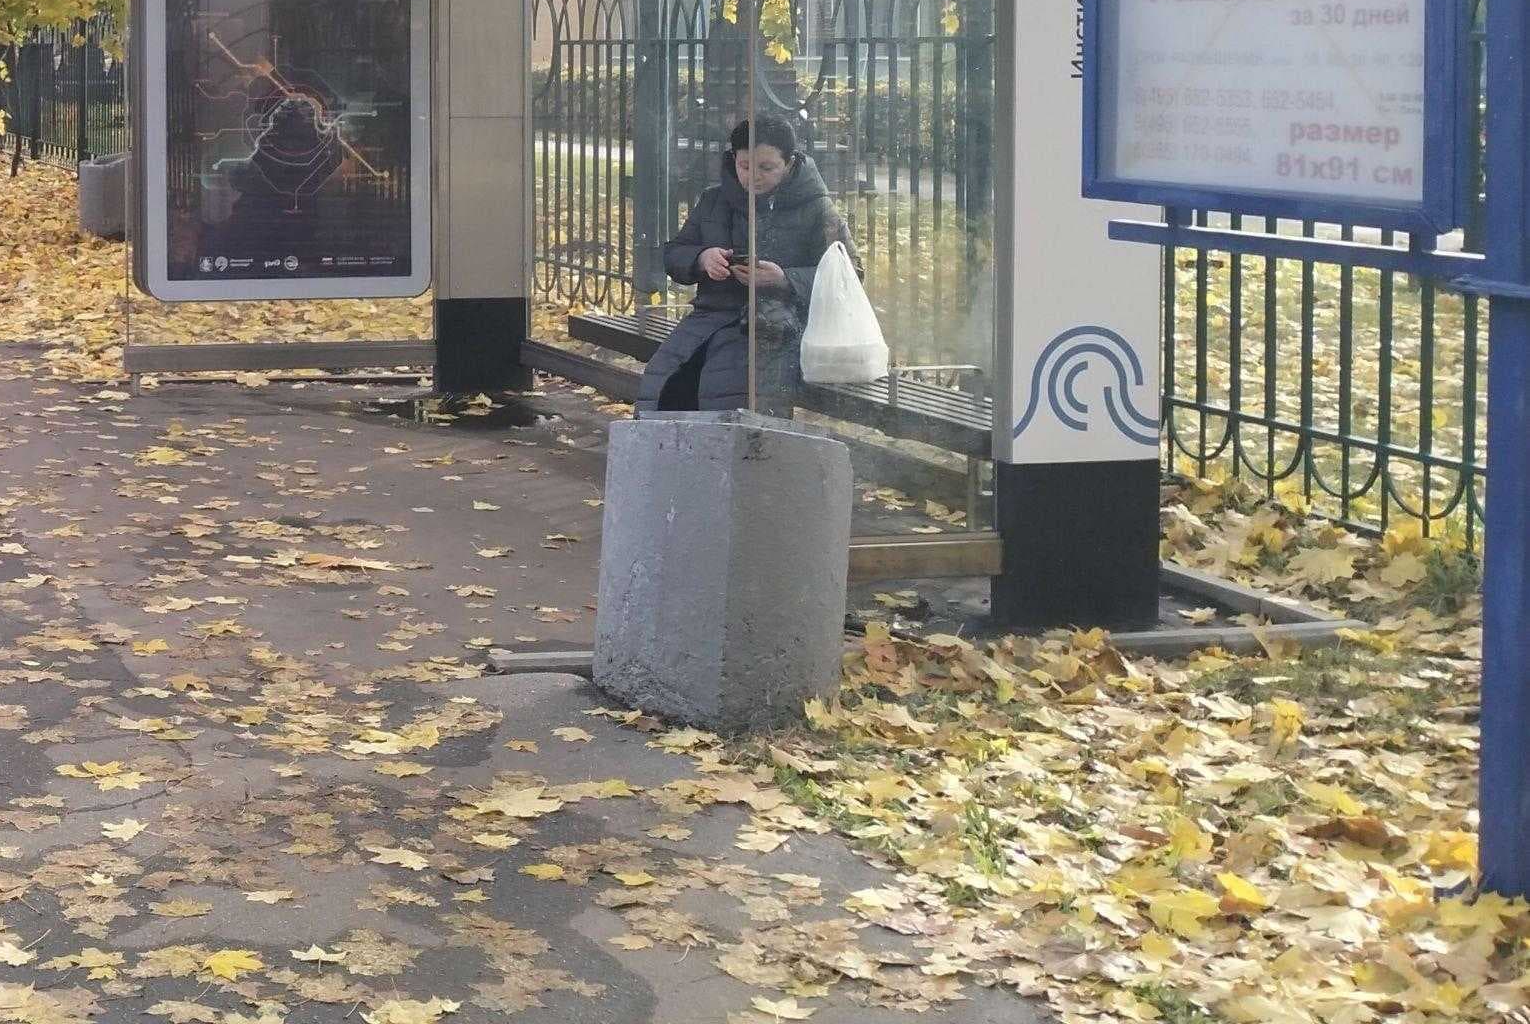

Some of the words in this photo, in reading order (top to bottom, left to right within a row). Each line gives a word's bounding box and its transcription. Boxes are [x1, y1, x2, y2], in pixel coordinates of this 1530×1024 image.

[1291, 9, 1315, 26] за
[1320, 3, 1346, 25] 30
[1352, 5, 1411, 28] дней
[1289, 123, 1402, 151] размер
[1372, 164, 1416, 186] см
